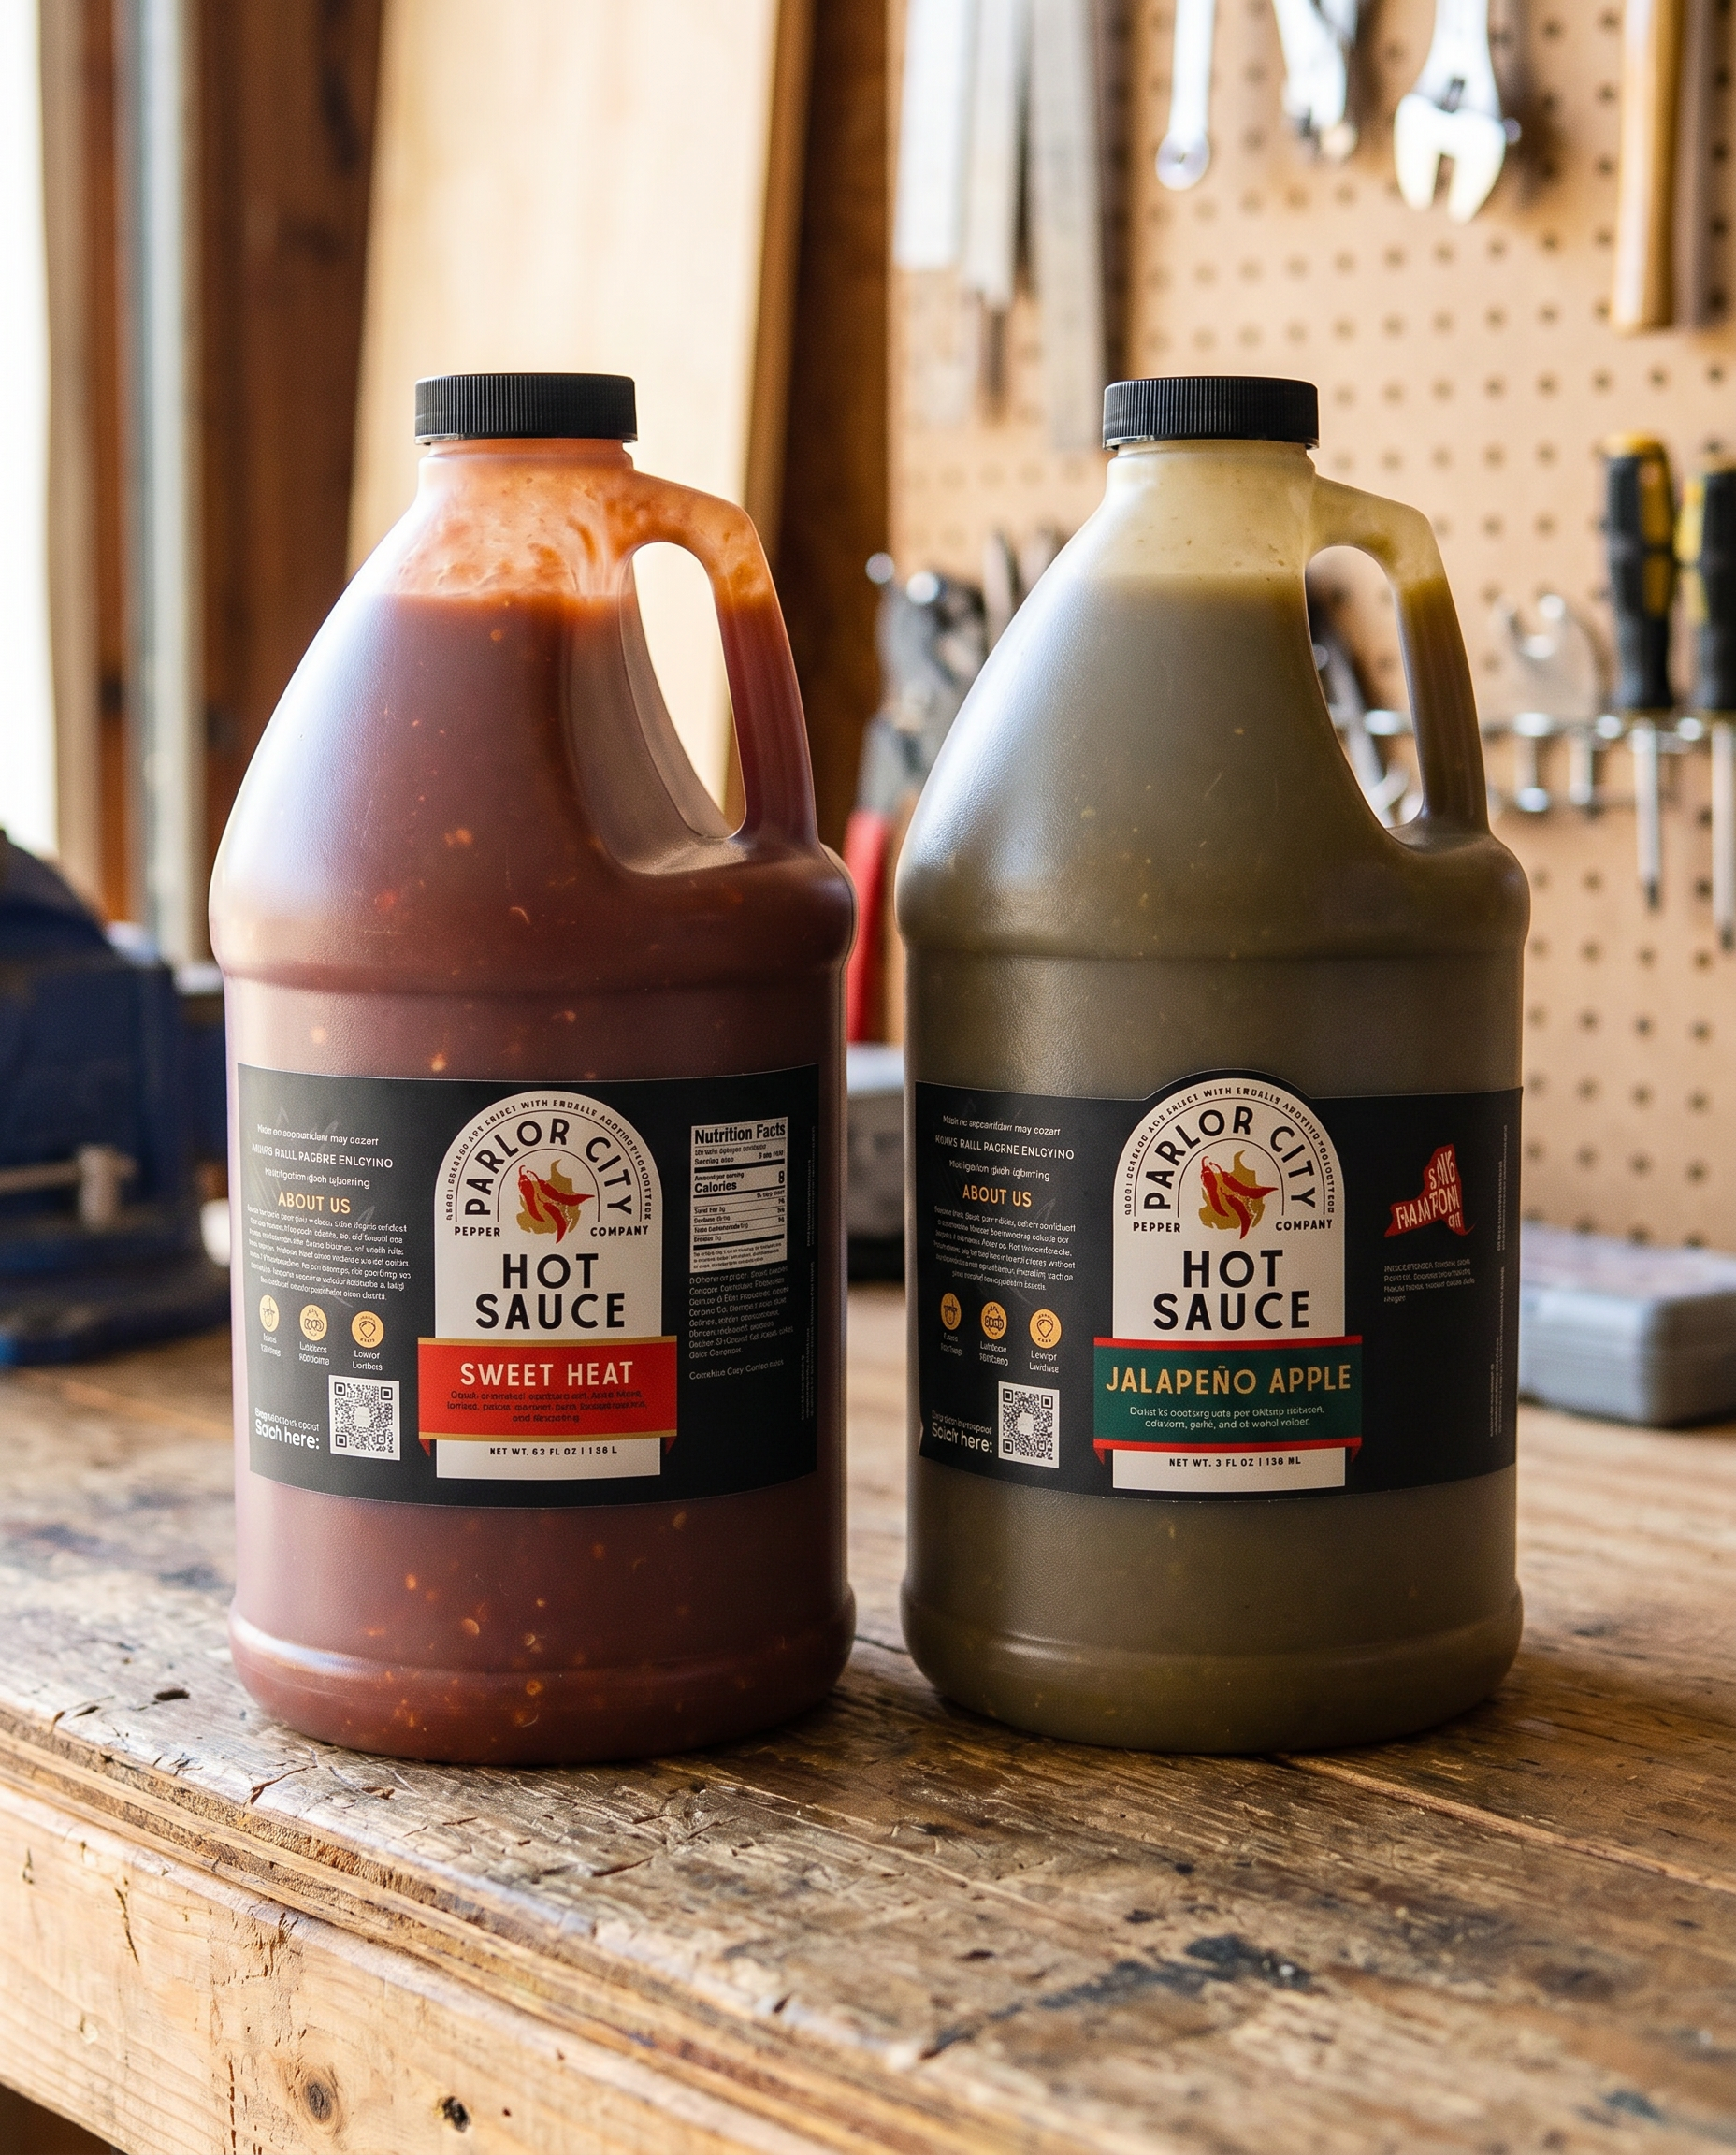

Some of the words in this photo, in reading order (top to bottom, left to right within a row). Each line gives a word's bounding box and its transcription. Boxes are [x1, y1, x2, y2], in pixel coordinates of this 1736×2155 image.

[1203, 1087, 1232, 1096] WITH
[521, 1100, 548, 1108] WITH
[695, 1127, 752, 1144] Nutrition
[757, 1122, 786, 1138] Facts
[1015, 1125, 1032, 1135] may
[465, 1118, 570, 1216] PARLOR
[586, 1136, 632, 1215] CITY
[1143, 1106, 1253, 1210] PARLOR
[1270, 1125, 1316, 1208] CITY
[695, 1181, 737, 1193] Calories
[962, 1184, 1006, 1205] ABOUT
[1012, 1191, 1032, 1208] US
[278, 1191, 324, 1211] ABOUT
[330, 1198, 351, 1214] US
[455, 1226, 500, 1237] PEPPER
[590, 1225, 648, 1237] COMPANY
[1133, 1222, 1180, 1233] PEPPER
[1275, 1219, 1332, 1231] COMPANY
[503, 1253, 599, 1289] HOT
[1183, 1250, 1283, 1288] HOT
[475, 1293, 625, 1330] SAUCE
[1153, 1290, 1309, 1331] SAUCE
[460, 1362, 554, 1386] SWEET
[567, 1361, 633, 1386] HEAT
[1106, 1365, 1257, 1395] JALAPEÑO
[1269, 1364, 1351, 1394] APPLE
[1219, 1420, 1237, 1428] and
[284, 1426, 319, 1449] here:
[961, 1430, 992, 1453] here:
[1169, 1458, 1188, 1467] NET
[1241, 1458, 1254, 1467] OZ
